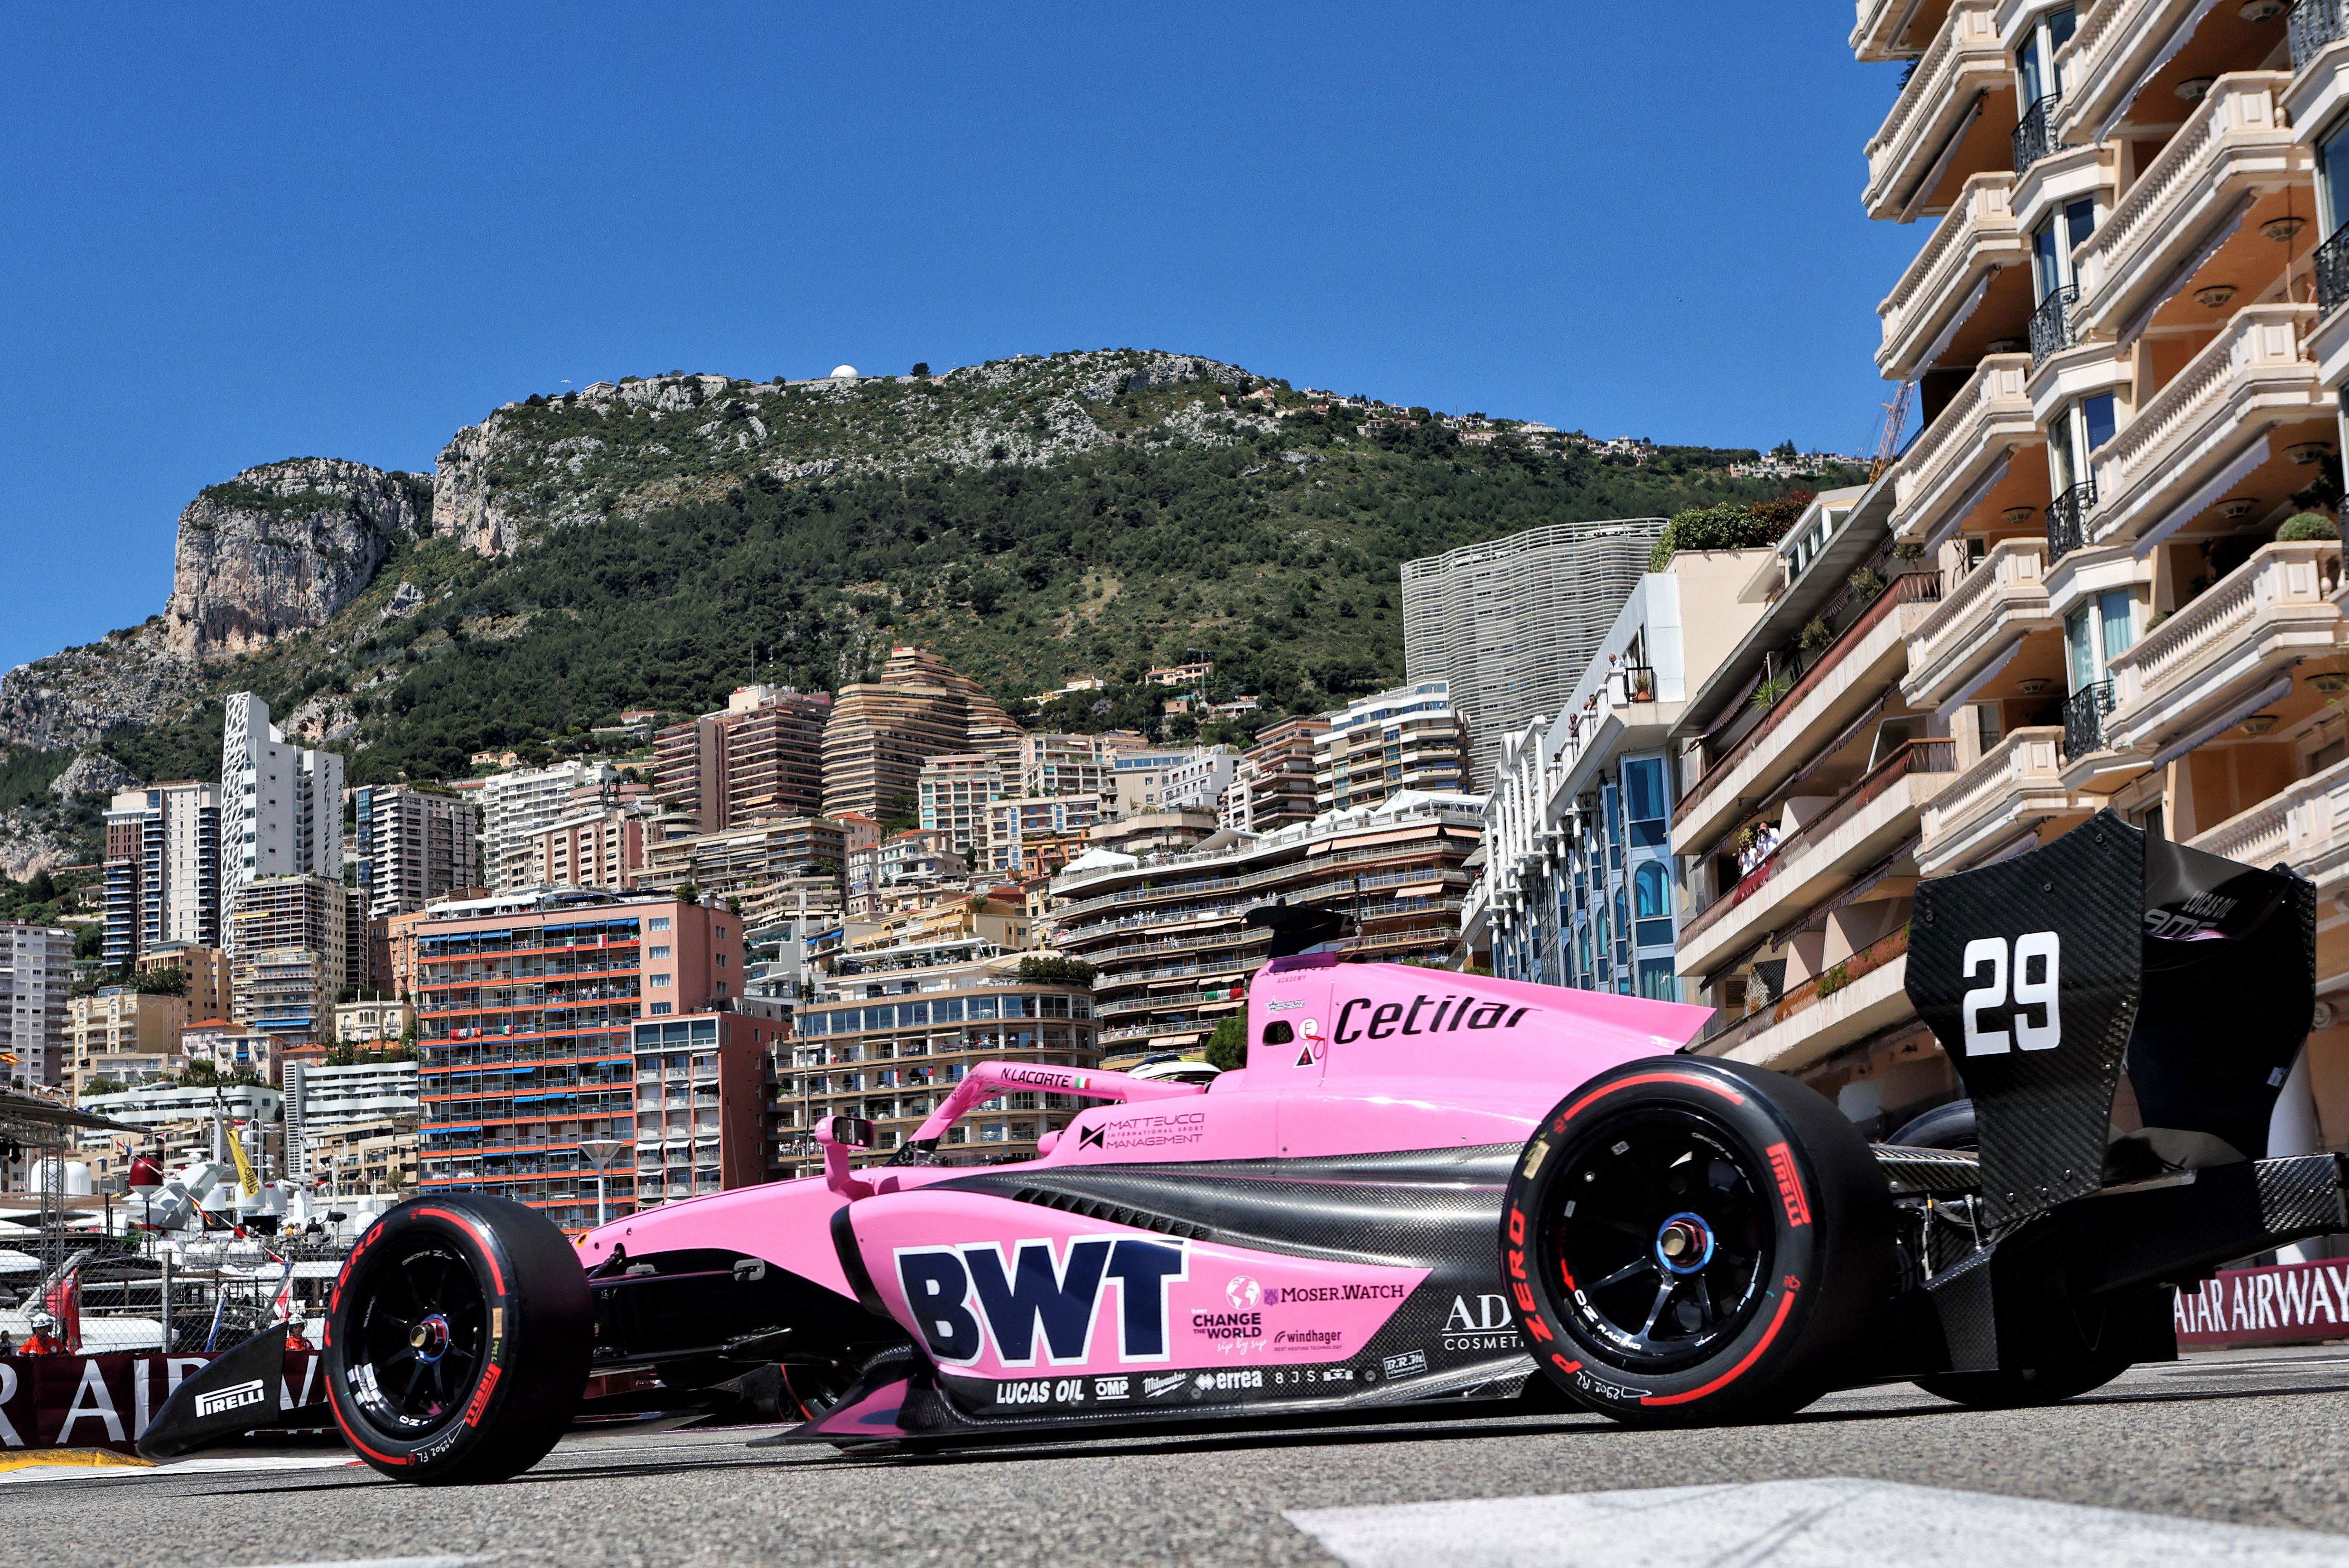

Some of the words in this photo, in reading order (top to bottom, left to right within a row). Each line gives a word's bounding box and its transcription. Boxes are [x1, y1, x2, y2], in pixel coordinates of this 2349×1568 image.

[2181, 890, 2224, 917] LUCAS
[2212, 897, 2238, 919] OIL
[1277, 975, 1306, 983] ACADEMY
[1962, 931, 2060, 1057] 29
[1304, 1022, 1312, 1036] E
[1334, 994, 1543, 1045] Cetilar
[1001, 1068, 1072, 1088] N.LACORTE
[1109, 1113, 1205, 1130] MATTEUCCI
[1106, 1134, 1203, 1149] MANAGEMENT
[1108, 1128, 1172, 1138] INTERNATIONAL
[1765, 1141, 1812, 1227] PIRELLI
[330, 1219, 388, 1314] ZERO
[1508, 1207, 1554, 1343] ZERO
[893, 1234, 1191, 1367] BWT
[1193, 1312, 1261, 1327] CHANGE
[1207, 1327, 1262, 1339] WORLD
[1287, 1329, 1342, 1345] windhager
[1597, 1323, 1642, 1350] RACING
[1551, 1353, 1583, 1374] P
[1095, 1381, 1129, 1396] OMP
[1142, 1372, 1187, 1394] Milwaukee
[1216, 1370, 1263, 1389] errea
[1577, 1370, 1591, 1389] RL
[194, 1379, 265, 1418] PIRELLI
[464, 1363, 502, 1427] PIRELLI
[996, 1381, 1051, 1404] LUCAS
[1056, 1380, 1085, 1403] OIL
[417, 1451, 429, 1462] FL
